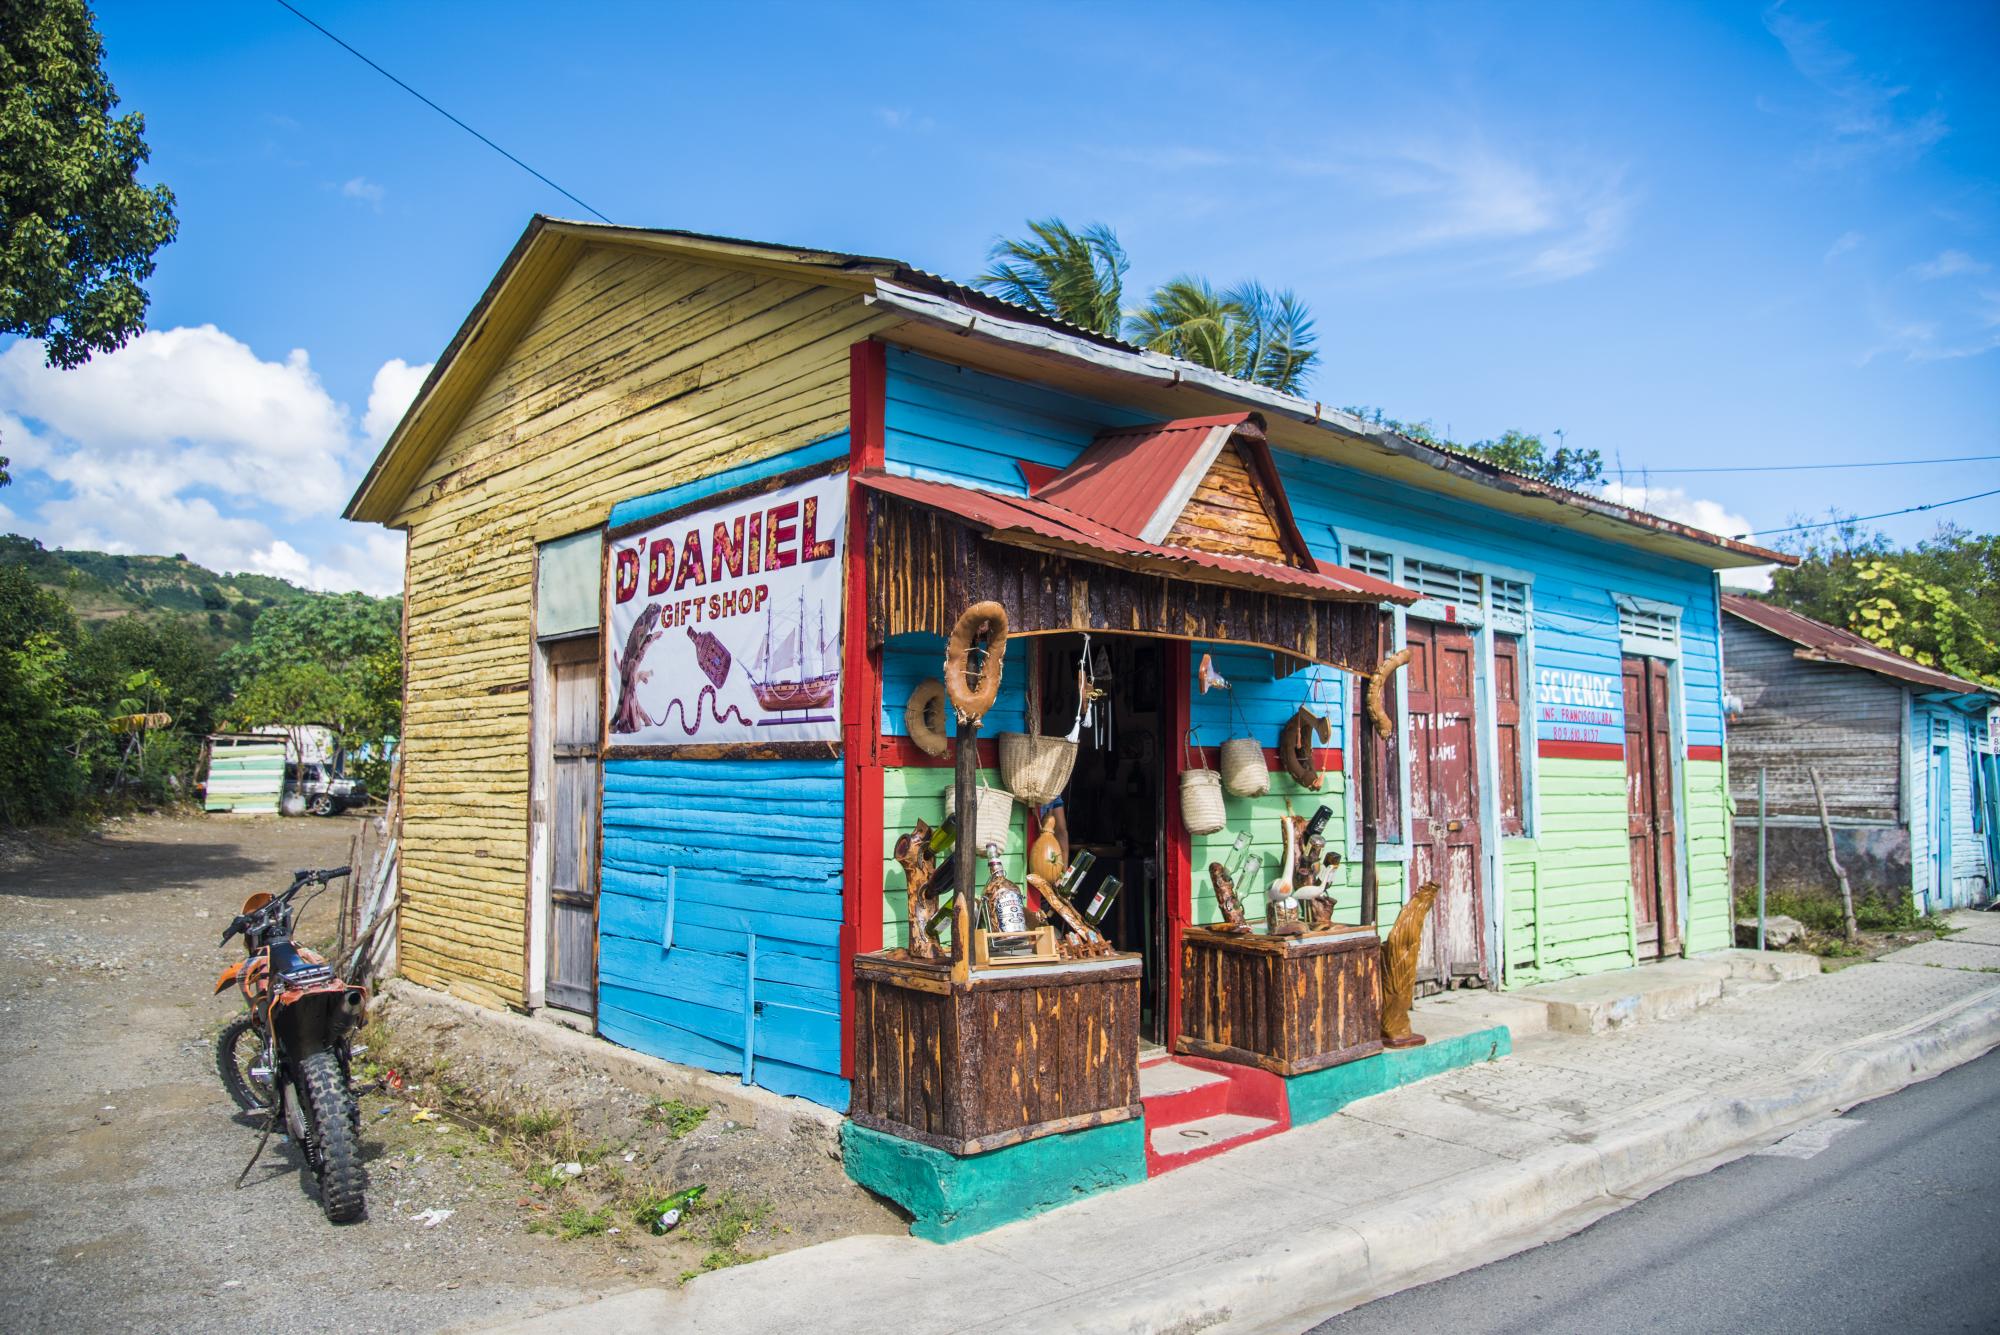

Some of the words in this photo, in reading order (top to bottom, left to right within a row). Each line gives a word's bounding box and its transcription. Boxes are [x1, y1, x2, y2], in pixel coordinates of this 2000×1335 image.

[615, 496, 836, 604] D'DANIEL
[661, 596, 706, 629] GIFT
[708, 584, 769, 620] SHOP
